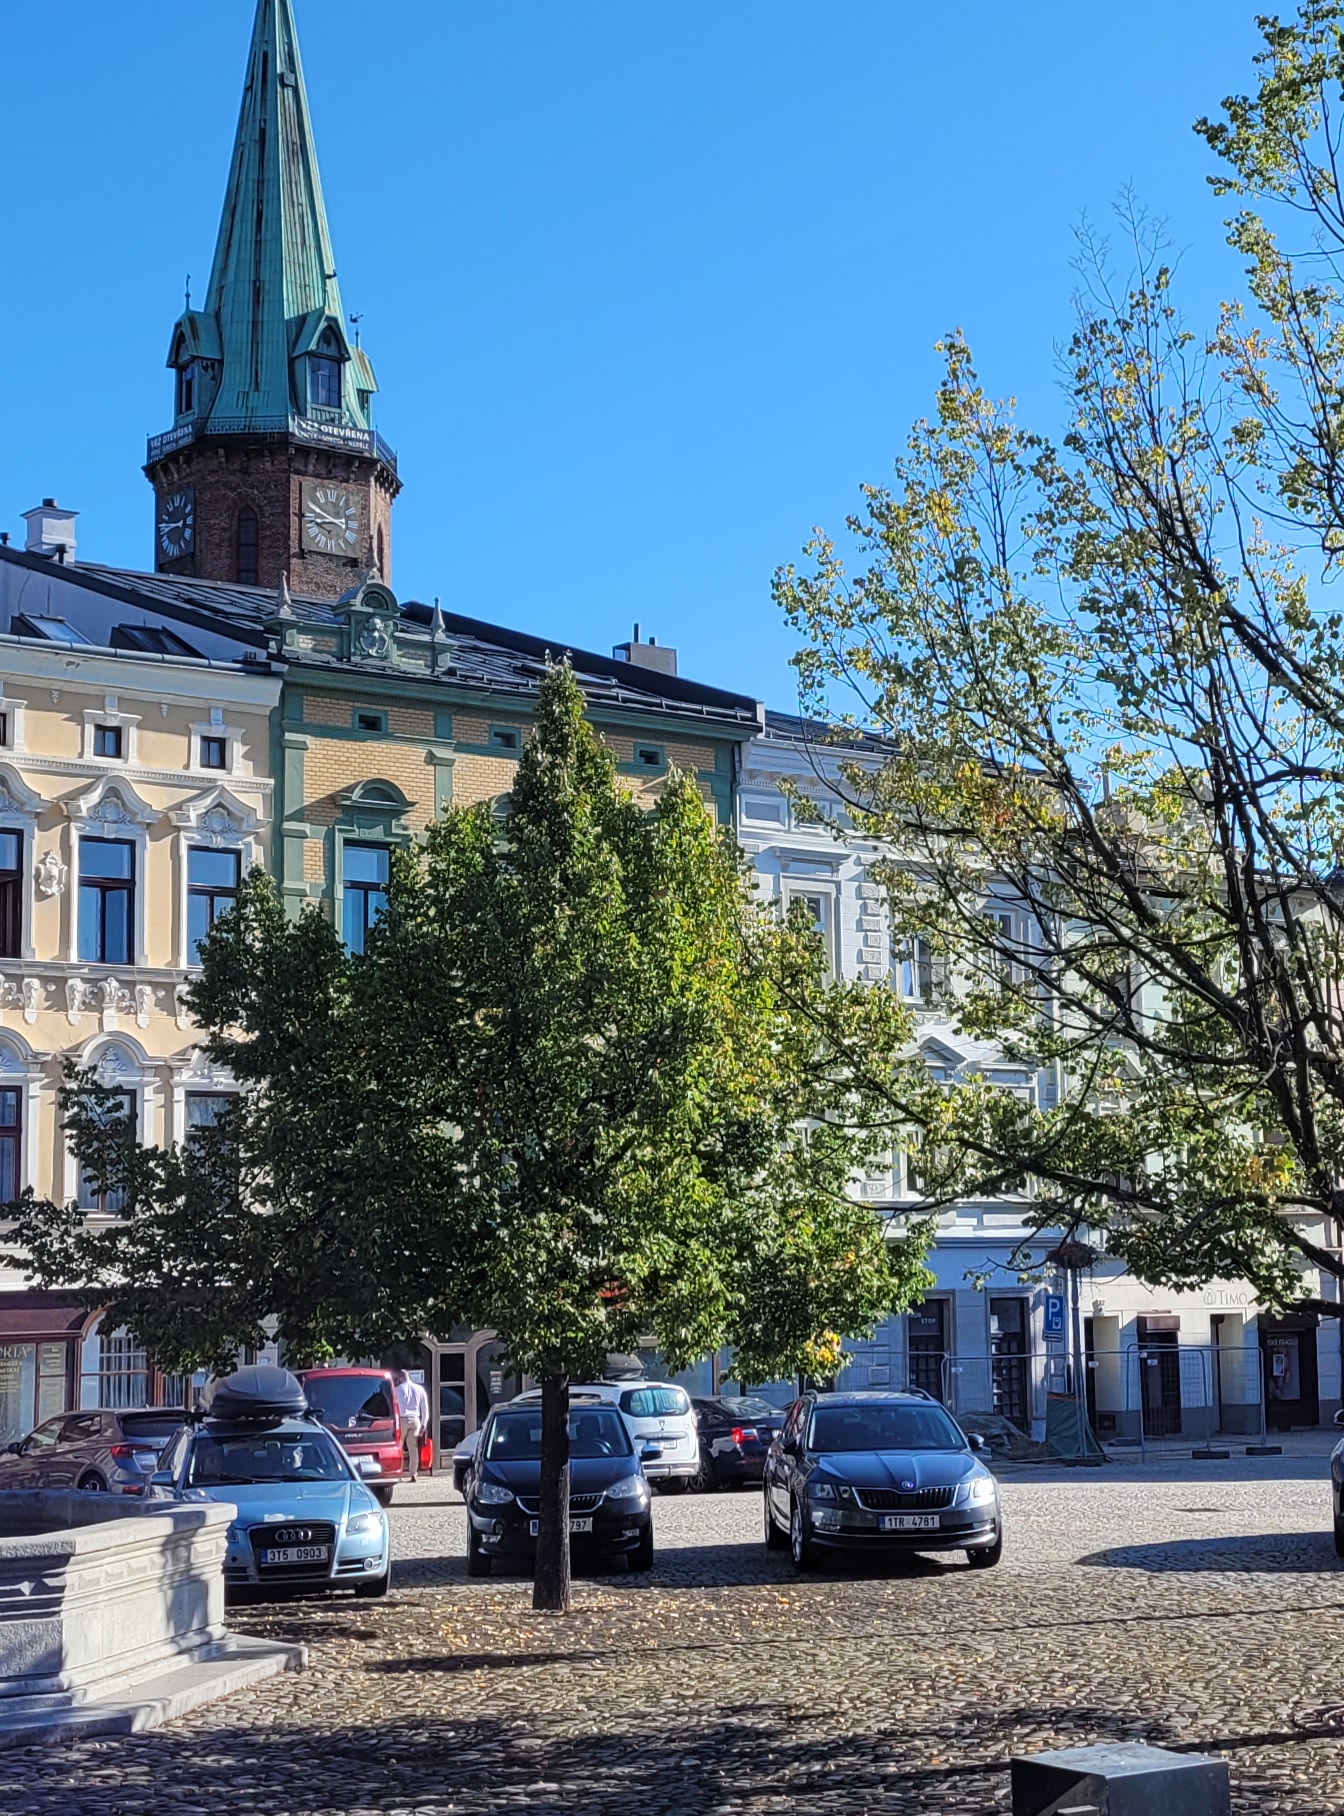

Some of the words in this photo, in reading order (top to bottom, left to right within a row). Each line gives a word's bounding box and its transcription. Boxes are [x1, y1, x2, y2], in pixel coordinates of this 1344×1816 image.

[163, 424, 193, 445] OTEVŘENA
[320, 424, 370, 441] OTEVŘENA
[570, 1520, 587, 1531] 797
[887, 1517, 905, 1528] 1TR
[911, 1516, 935, 1527] 4781
[269, 1549, 289, 1561] 3T5
[296, 1547, 322, 1560] 0903
